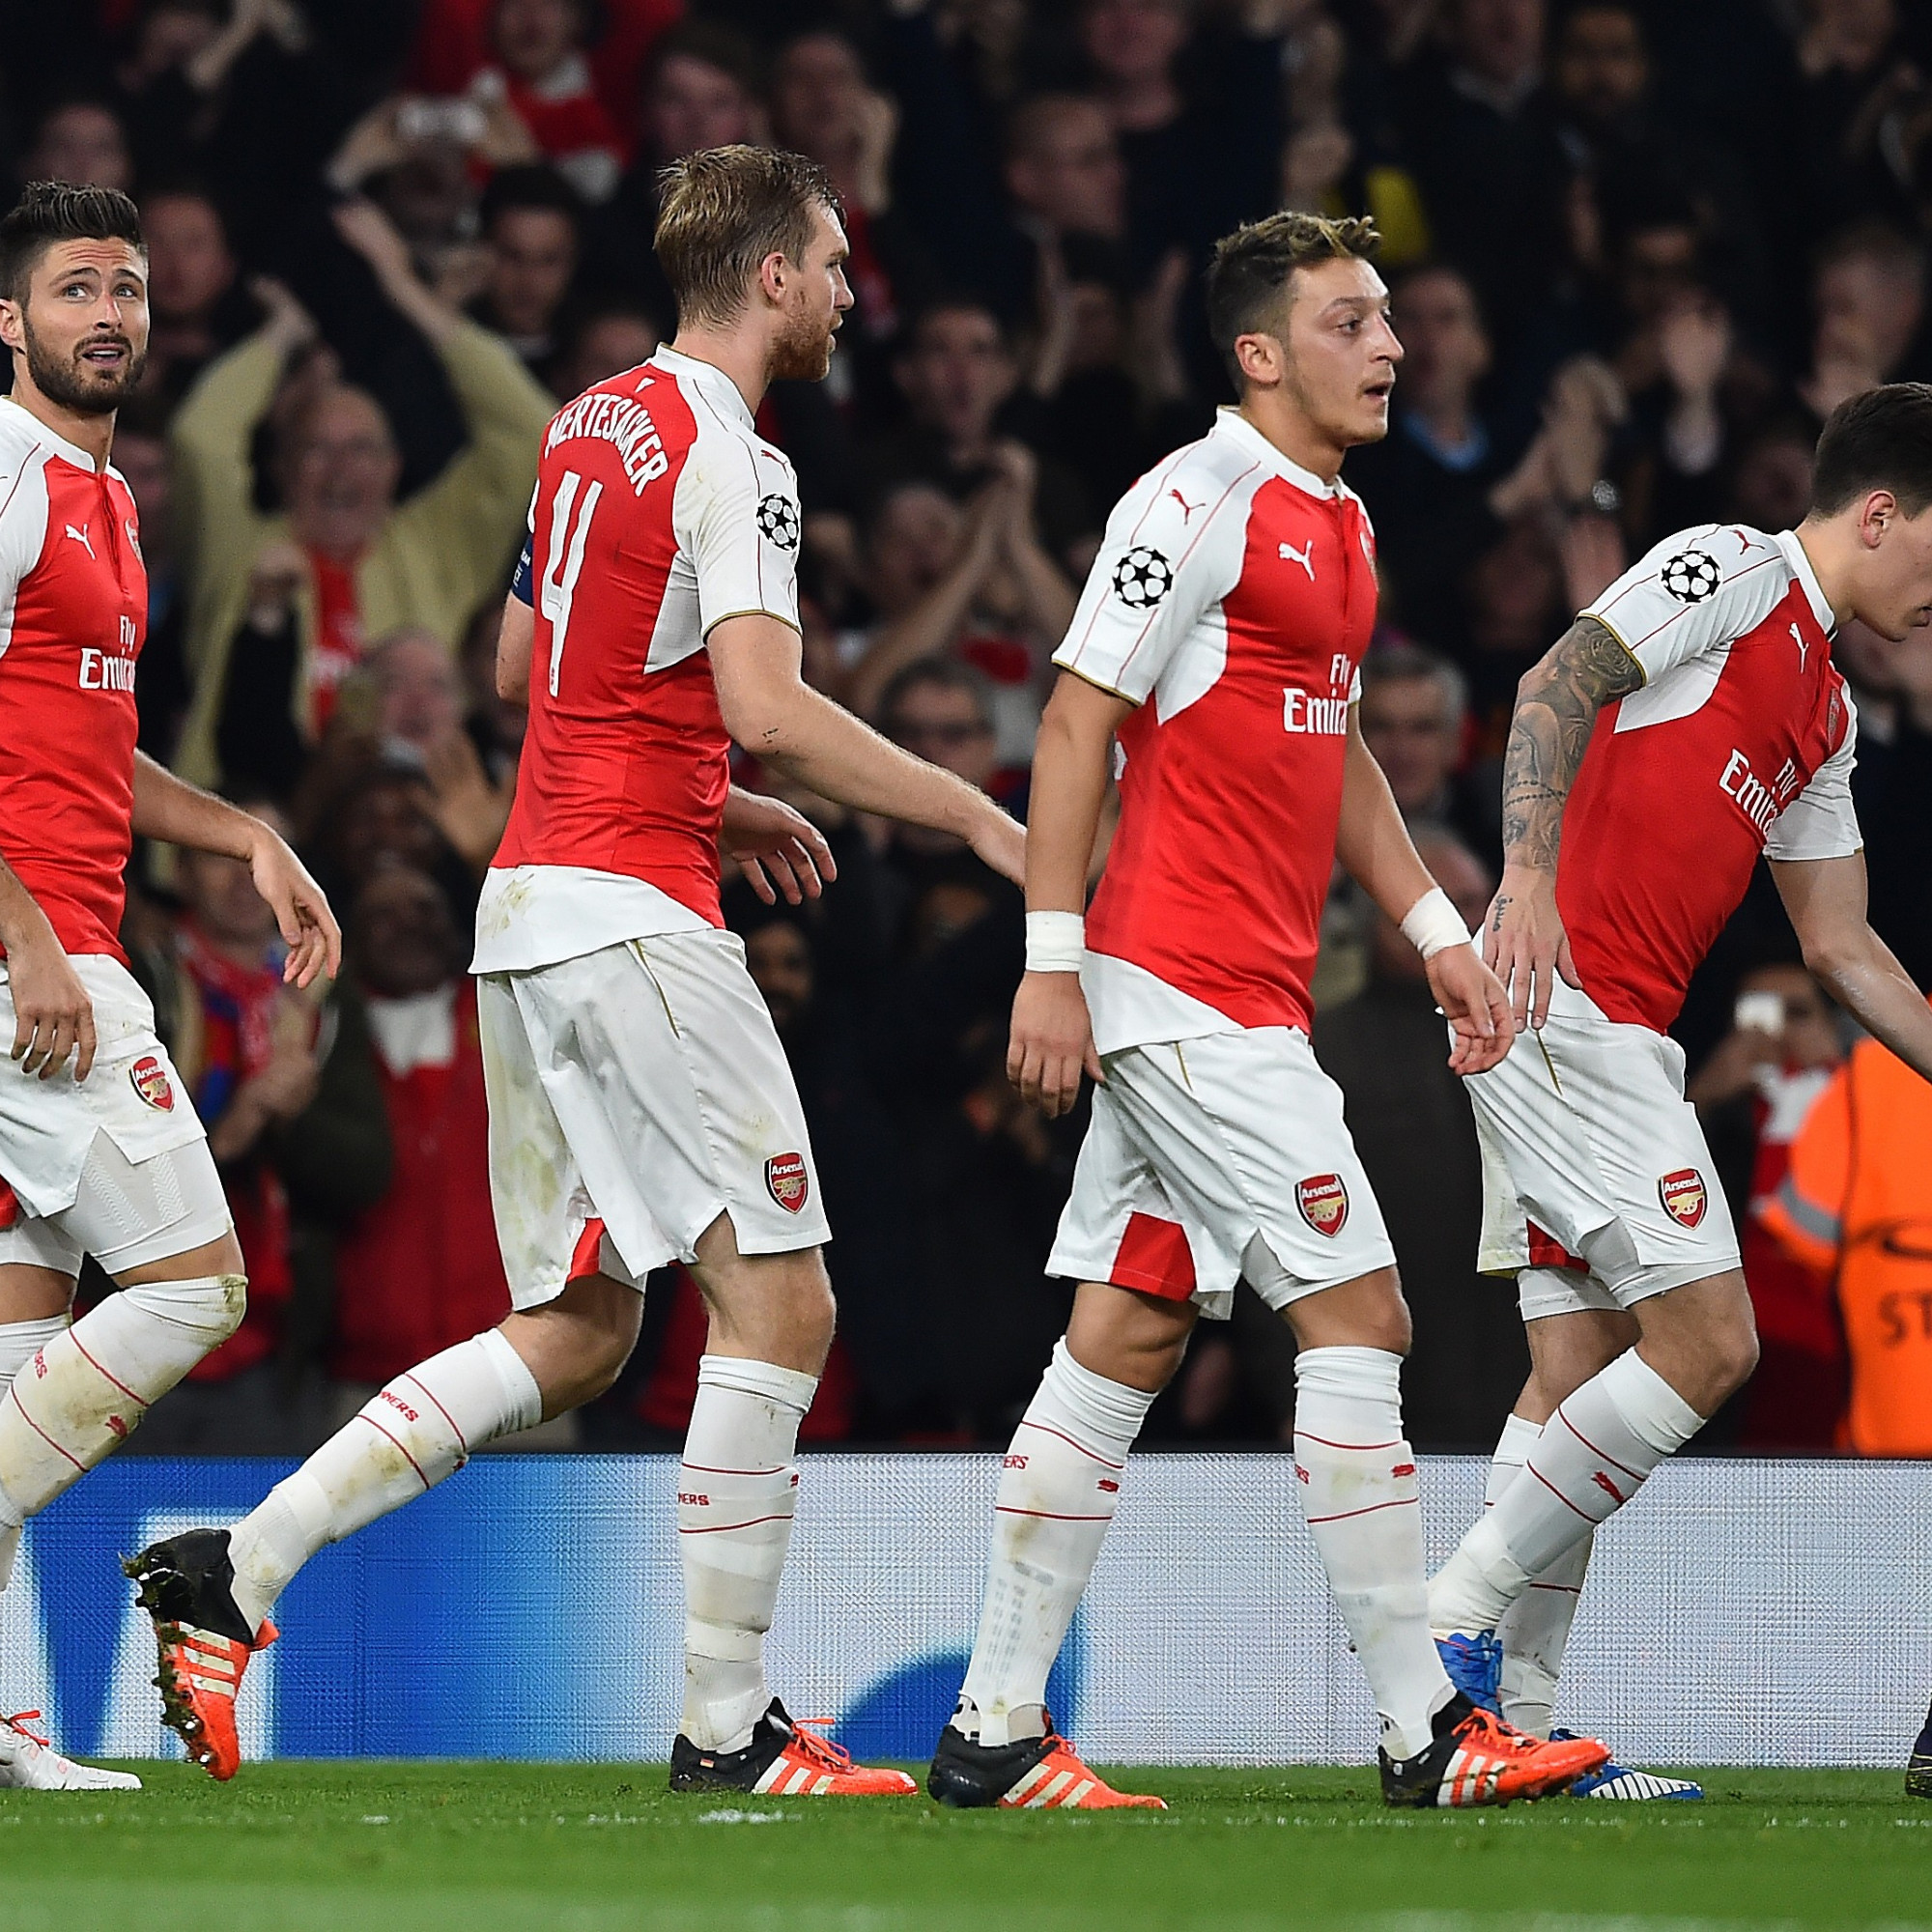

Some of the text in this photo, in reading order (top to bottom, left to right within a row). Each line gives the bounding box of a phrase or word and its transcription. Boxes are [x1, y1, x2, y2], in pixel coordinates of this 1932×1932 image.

[541, 470, 604, 697] 4
[120, 614, 136, 652] Fly
[1329, 653, 1351, 690] Fly
